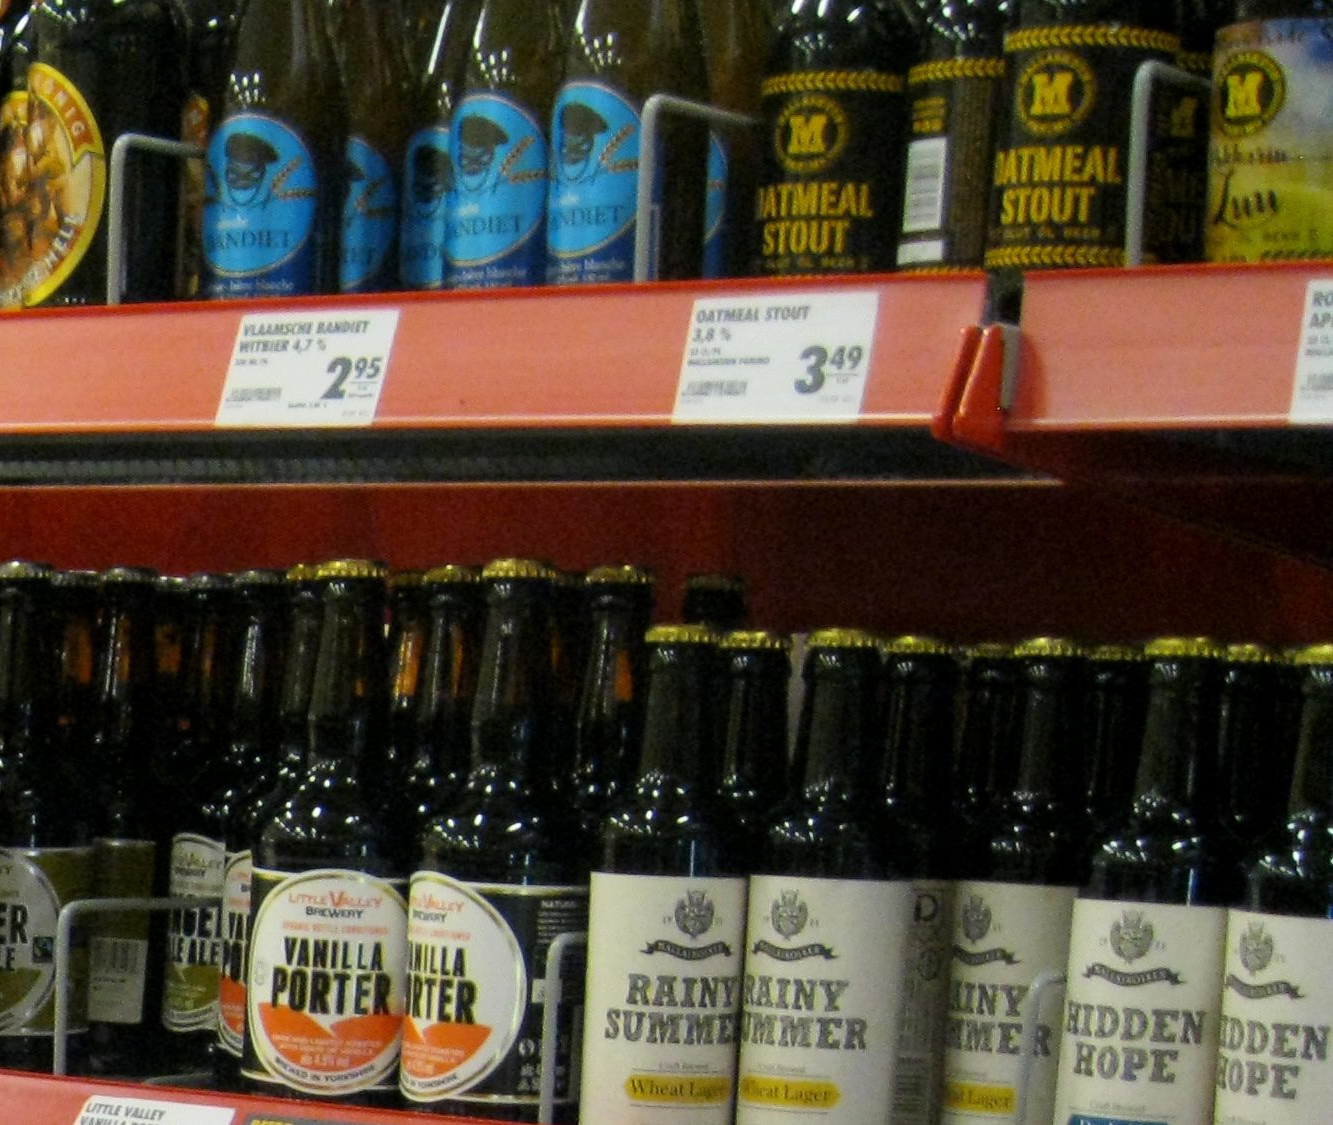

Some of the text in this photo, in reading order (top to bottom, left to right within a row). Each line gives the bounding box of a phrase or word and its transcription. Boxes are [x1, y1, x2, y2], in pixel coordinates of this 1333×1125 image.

[1032, 71, 1073, 115] M
[788, 114, 828, 155] M
[1002, 186, 1095, 225] STOUT
[763, 218, 850, 256] STOUT
[316, 320, 370, 335] BANDIET
[696, 306, 810, 323] OATMEAL STOUT
[305, 906, 363, 920] BREWERY
[329, 889, 383, 910] VALLEY
[283, 937, 384, 972] VANILLA
[271, 968, 393, 1016] PORTER
[1066, 999, 1208, 1046] HIDDEN
[1073, 1041, 1181, 1083] HOPE
[631, 1078, 684, 1098] Wheat
[783, 1082, 832, 1105] Lager
[85, 1103, 166, 1122] LITTLE VALLEY
